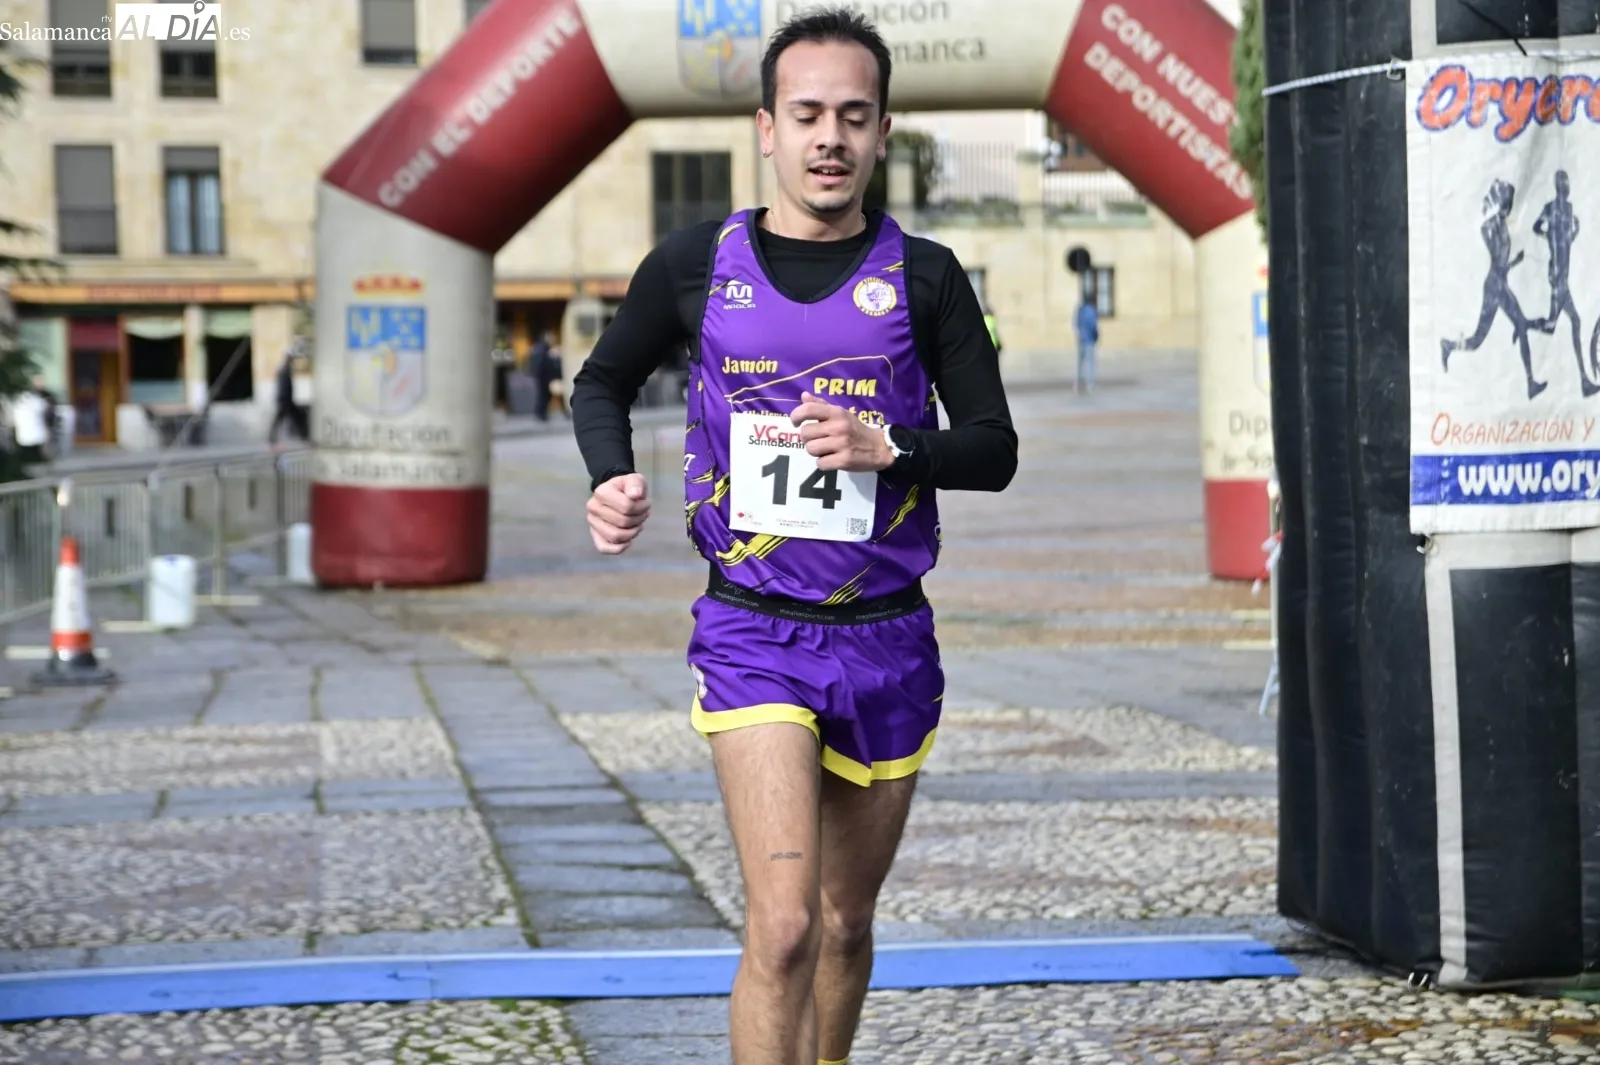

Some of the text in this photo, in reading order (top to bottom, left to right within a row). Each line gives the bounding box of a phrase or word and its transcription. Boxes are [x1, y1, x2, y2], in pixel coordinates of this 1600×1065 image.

[1101, 4, 1164, 64] CON
[466, 8, 582, 126] DEPORTE
[1083, 41, 1254, 200] DEPORTISTAS
[721, 356, 779, 375] Jamón
[813, 377, 877, 397] PRIM
[761, 454, 842, 510] 14
